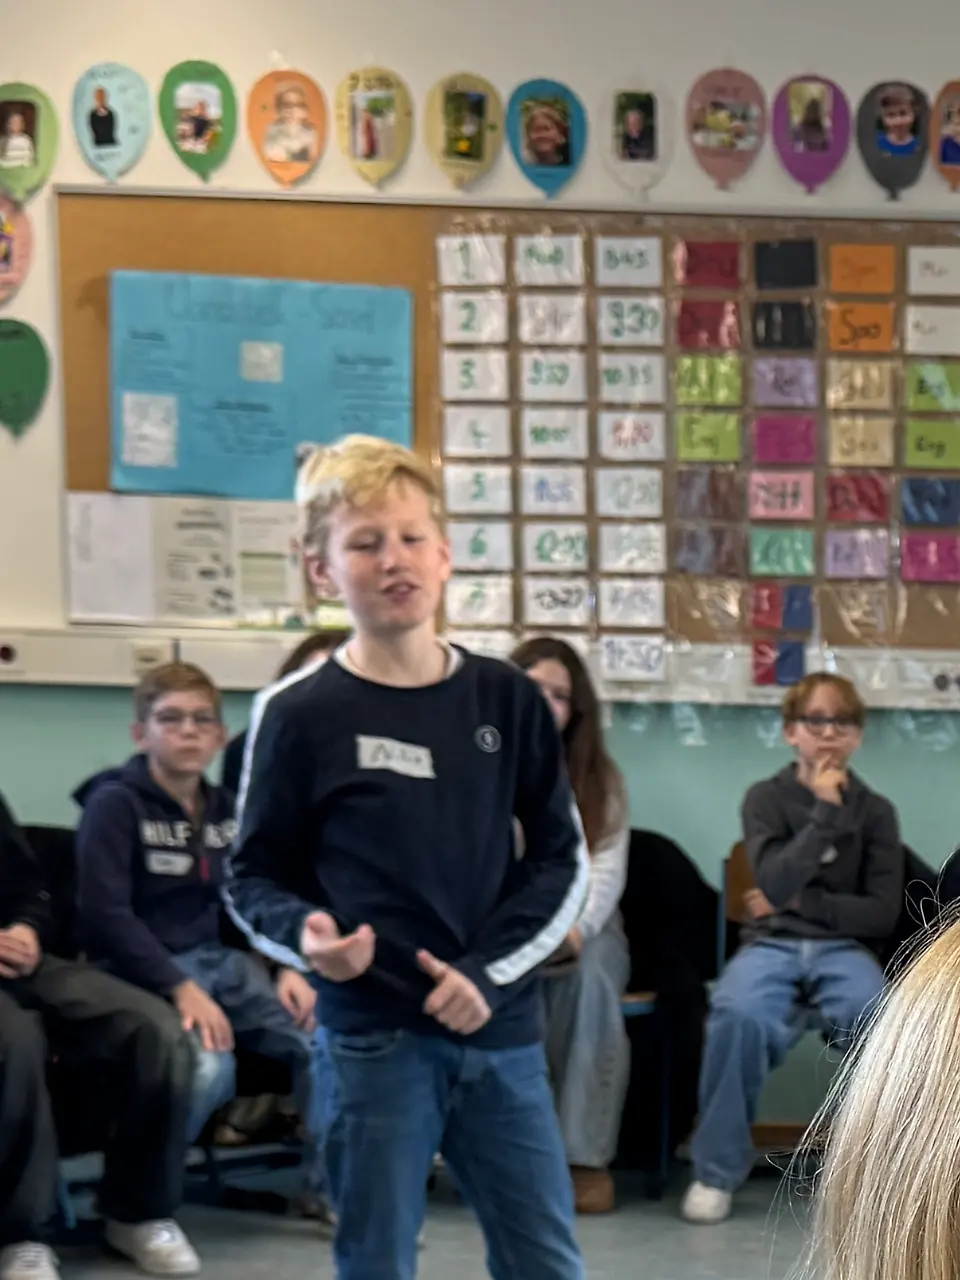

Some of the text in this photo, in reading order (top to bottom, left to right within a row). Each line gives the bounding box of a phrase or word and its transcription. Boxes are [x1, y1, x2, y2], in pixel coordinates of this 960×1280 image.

[457, 300, 478, 332] 2
[458, 358, 477, 390] 3
[469, 527, 488, 557] 6
